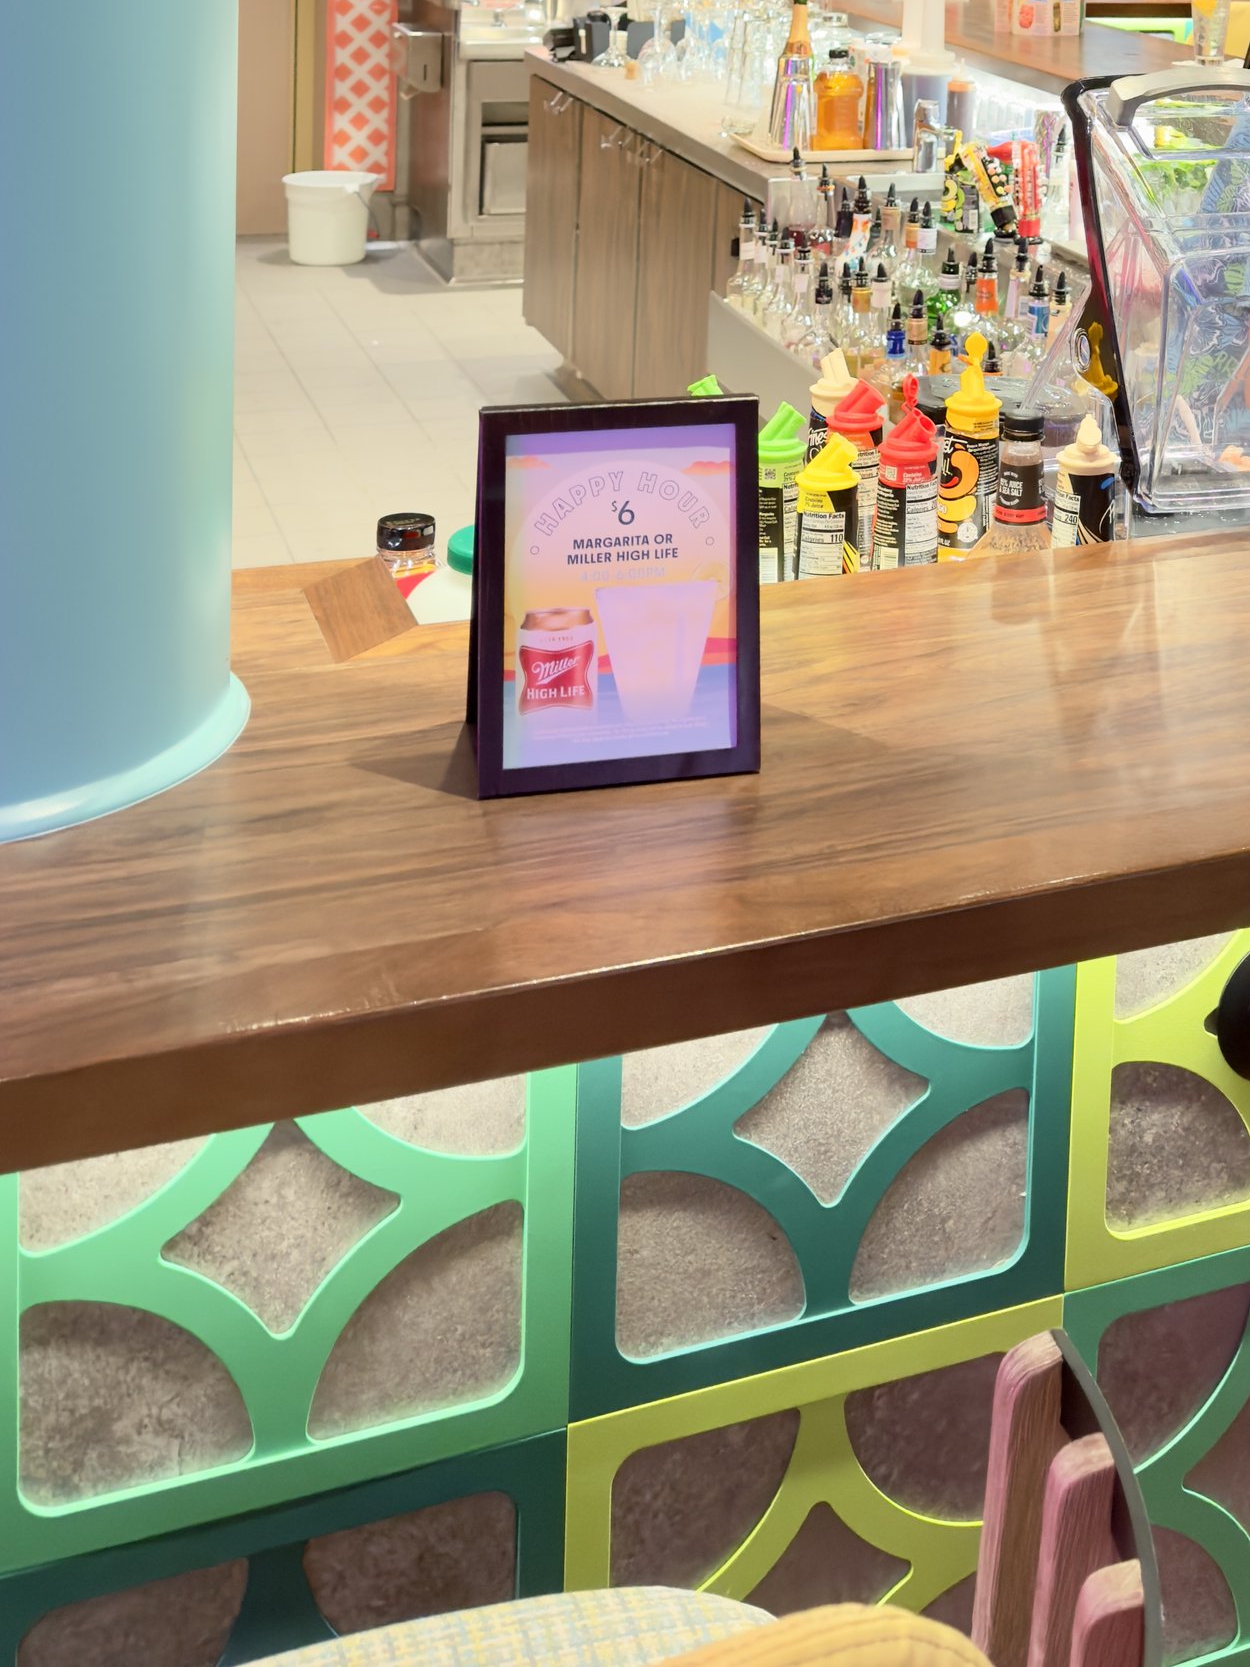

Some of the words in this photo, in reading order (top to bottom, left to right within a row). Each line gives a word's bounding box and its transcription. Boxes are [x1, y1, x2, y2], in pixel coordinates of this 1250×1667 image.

[1009, 480, 1024, 490] JUICE
[1012, 488, 1024, 497] SALT
[534, 470, 624, 537] HAPPY
[637, 471, 711, 530] HOUR
[611, 500, 635, 526] $6
[1064, 514, 1078, 524] 240
[573, 534, 650, 550] MARGARITA
[654, 533, 674, 545] OR
[831, 534, 844, 543] 110
[567, 552, 612, 565] MILLER
[616, 549, 651, 562] HIGH
[654, 547, 679, 560] LIFE
[531, 656, 580, 685] Miller
[526, 688, 558, 700] HIGH
[560, 685, 586, 698] LIFE
